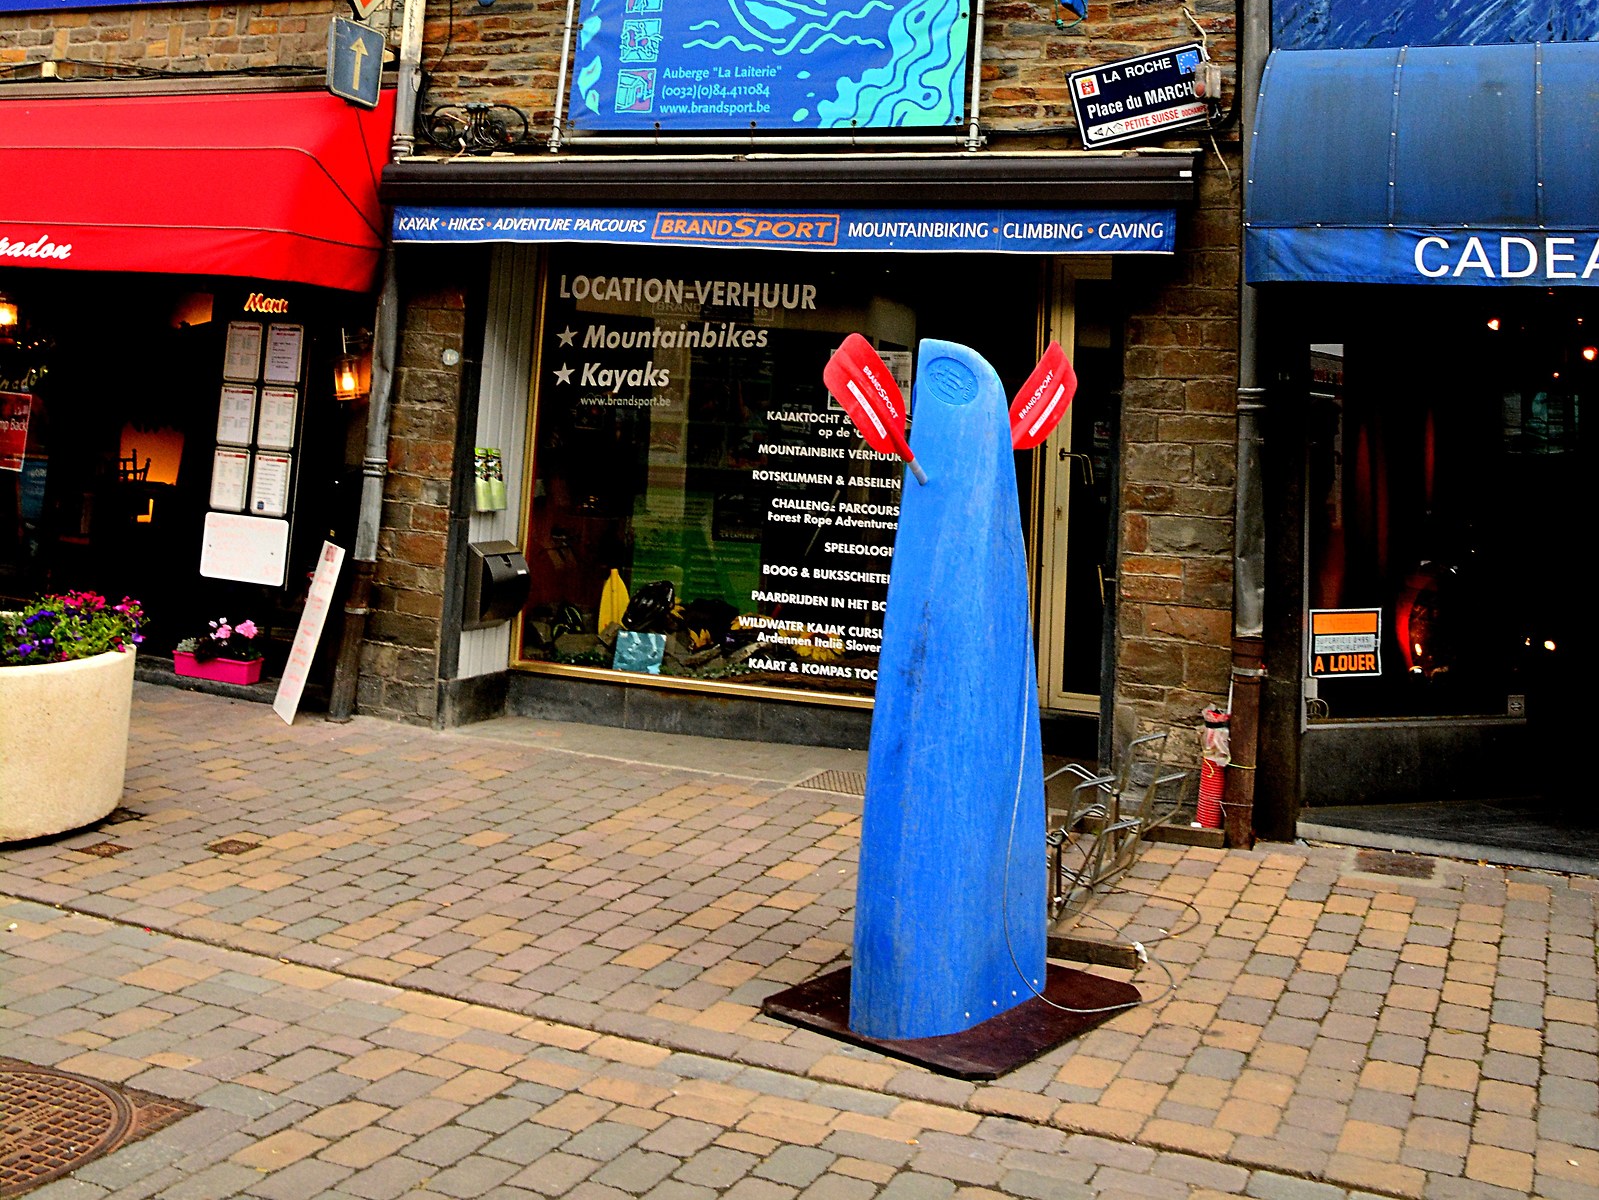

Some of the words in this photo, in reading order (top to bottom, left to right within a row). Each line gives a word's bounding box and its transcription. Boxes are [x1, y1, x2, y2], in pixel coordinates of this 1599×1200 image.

[663, 67, 710, 82] Auberge
[713, 67, 731, 78] "La
[735, 65, 782, 78] Laiterie"
[1102, 70, 1121, 84] LA
[1125, 57, 1172, 79] ROCHE
[661, 83, 770, 99] (0032)(0)84.411084
[1086, 100, 1124, 119] Place
[1126, 95, 1143, 110] du
[1144, 80, 1197, 105] MARCH
[660, 100, 771, 116] www.brandsport.be
[1124, 116, 1151, 131] PETITE
[1152, 109, 1179, 124] SUISSE
[398, 216, 440, 231] KAYAK
[448, 217, 485, 231] HIKES
[492, 218, 573, 231] ADVENTURE
[573, 218, 647, 233] PARCOURS
[661, 218, 833, 238] BRANDSPORT
[848, 221, 989, 238] MOUNTAINBIKING
[1003, 222, 1083, 239] CLIMBING
[1098, 222, 1164, 239] CAVING
[560, 274, 817, 310] LOCATION-VERHUUR
[244, 292, 289, 313] Menu
[582, 322, 768, 349] Mountainbikes
[580, 362, 671, 393] Kayaks
[580, 394, 671, 409] www.brandsport.be
[862, 365, 899, 419] BRANDSPORT
[1018, 369, 1055, 420] BRANDSPORT
[767, 411, 840, 424] KAJAKTOCHT
[843, 416, 852, 425] &
[818, 428, 833, 439] op
[836, 426, 850, 438] de
[758, 444, 845, 459] MOUNTAINBIKE
[752, 470, 833, 485] ROTSKLIMMEN
[836, 475, 845, 486] &
[848, 476, 901, 489] ABSEILEN
[839, 503, 900, 517] PARCOURS
[768, 511, 801, 523] Forest
[804, 513, 832, 527] Rope
[835, 516, 899, 530] Adventures
[824, 542, 894, 557] SPELEOLOGI
[763, 564, 798, 577] BOOG
[801, 568, 810, 579] &
[752, 590, 828, 607] PAARDRIJDEN
[831, 597, 845, 608] IN
[847, 599, 869, 611] HET
[738, 616, 804, 631] WILDWATER
[807, 623, 845, 636] KAJAK
[757, 632, 811, 646] Ardennen
[814, 637, 843, 650] Italië
[748, 658, 787, 672] KAART
[789, 662, 798, 673] &
[801, 663, 852, 678] KOMPAS
[1314, 655, 1325, 672] A
[1329, 653, 1376, 672] LOUER
